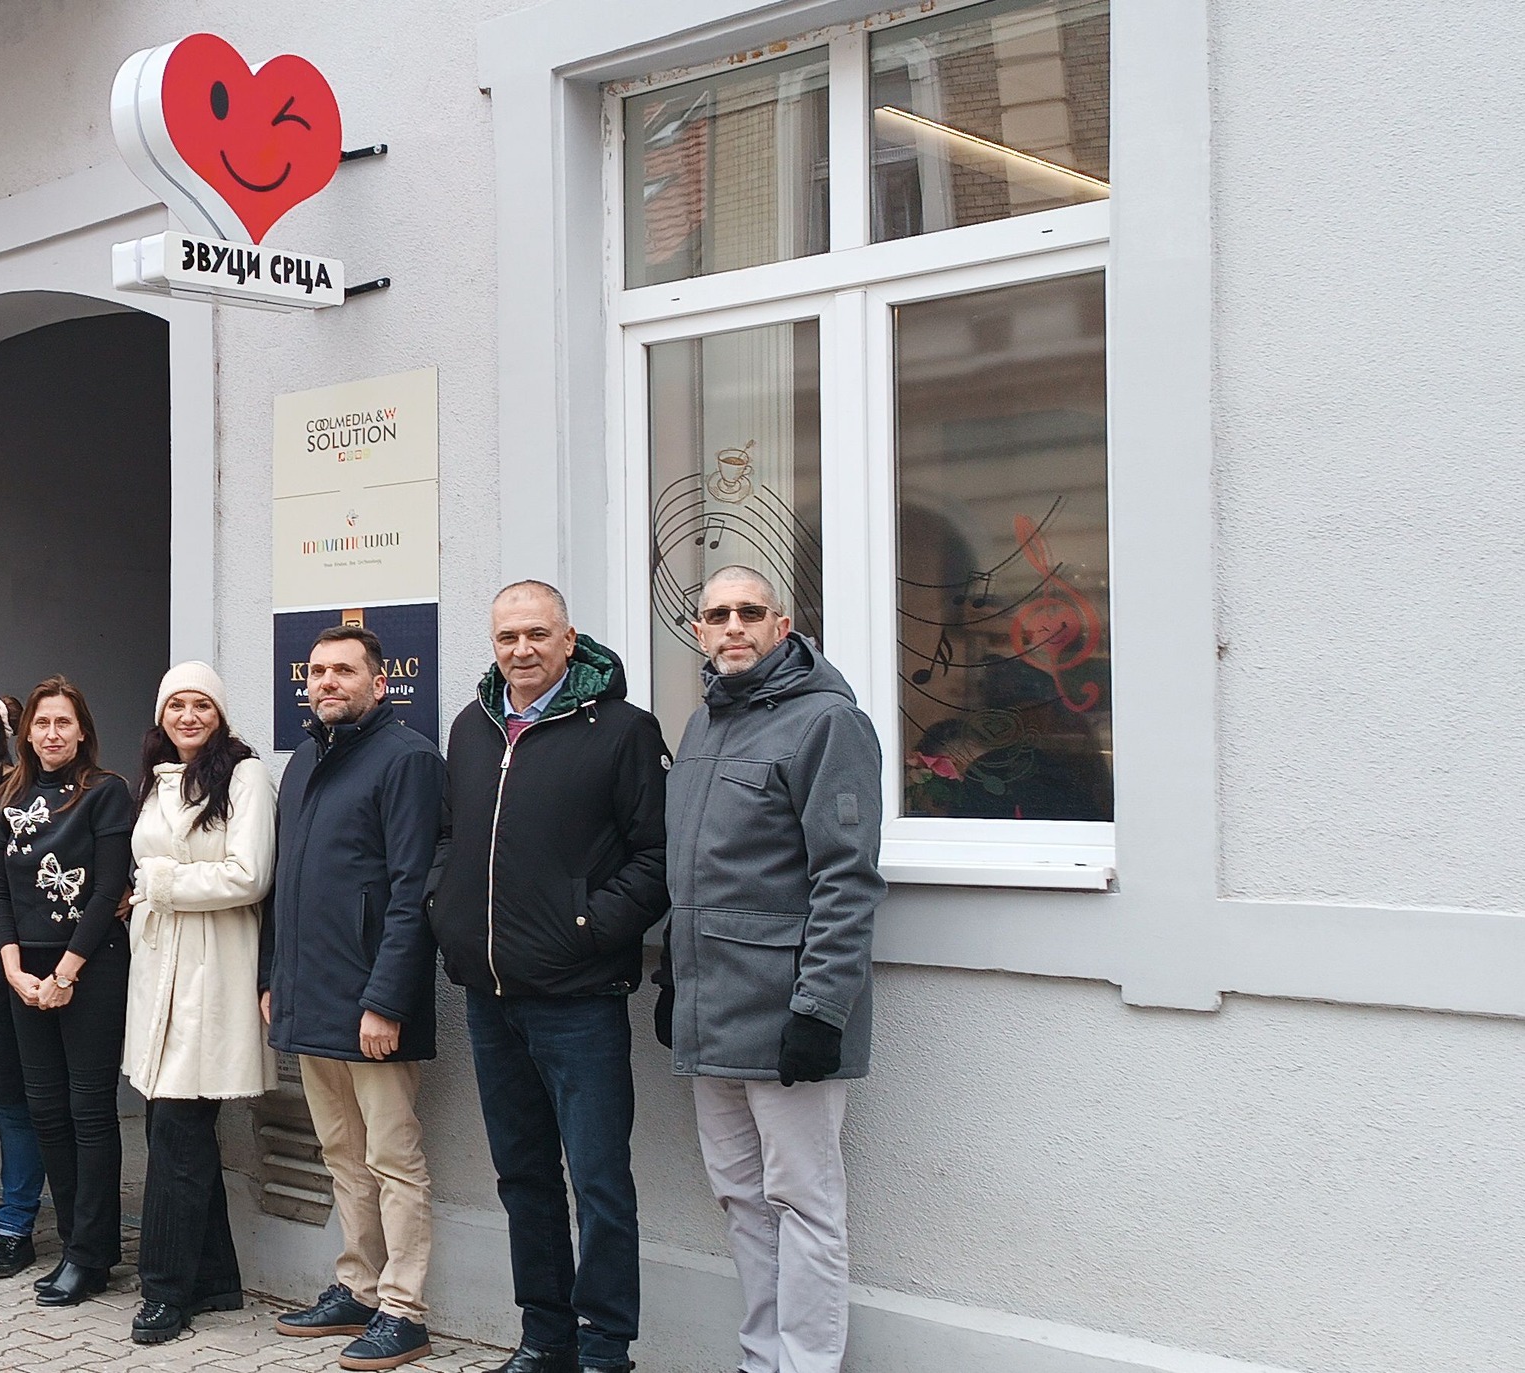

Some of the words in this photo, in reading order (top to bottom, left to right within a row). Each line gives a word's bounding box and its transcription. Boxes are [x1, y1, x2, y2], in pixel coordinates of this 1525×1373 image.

[182, 240, 261, 285] ЗВУЦИ
[270, 254, 333, 294] СРЦА
[307, 422, 397, 452] SOLUTION
